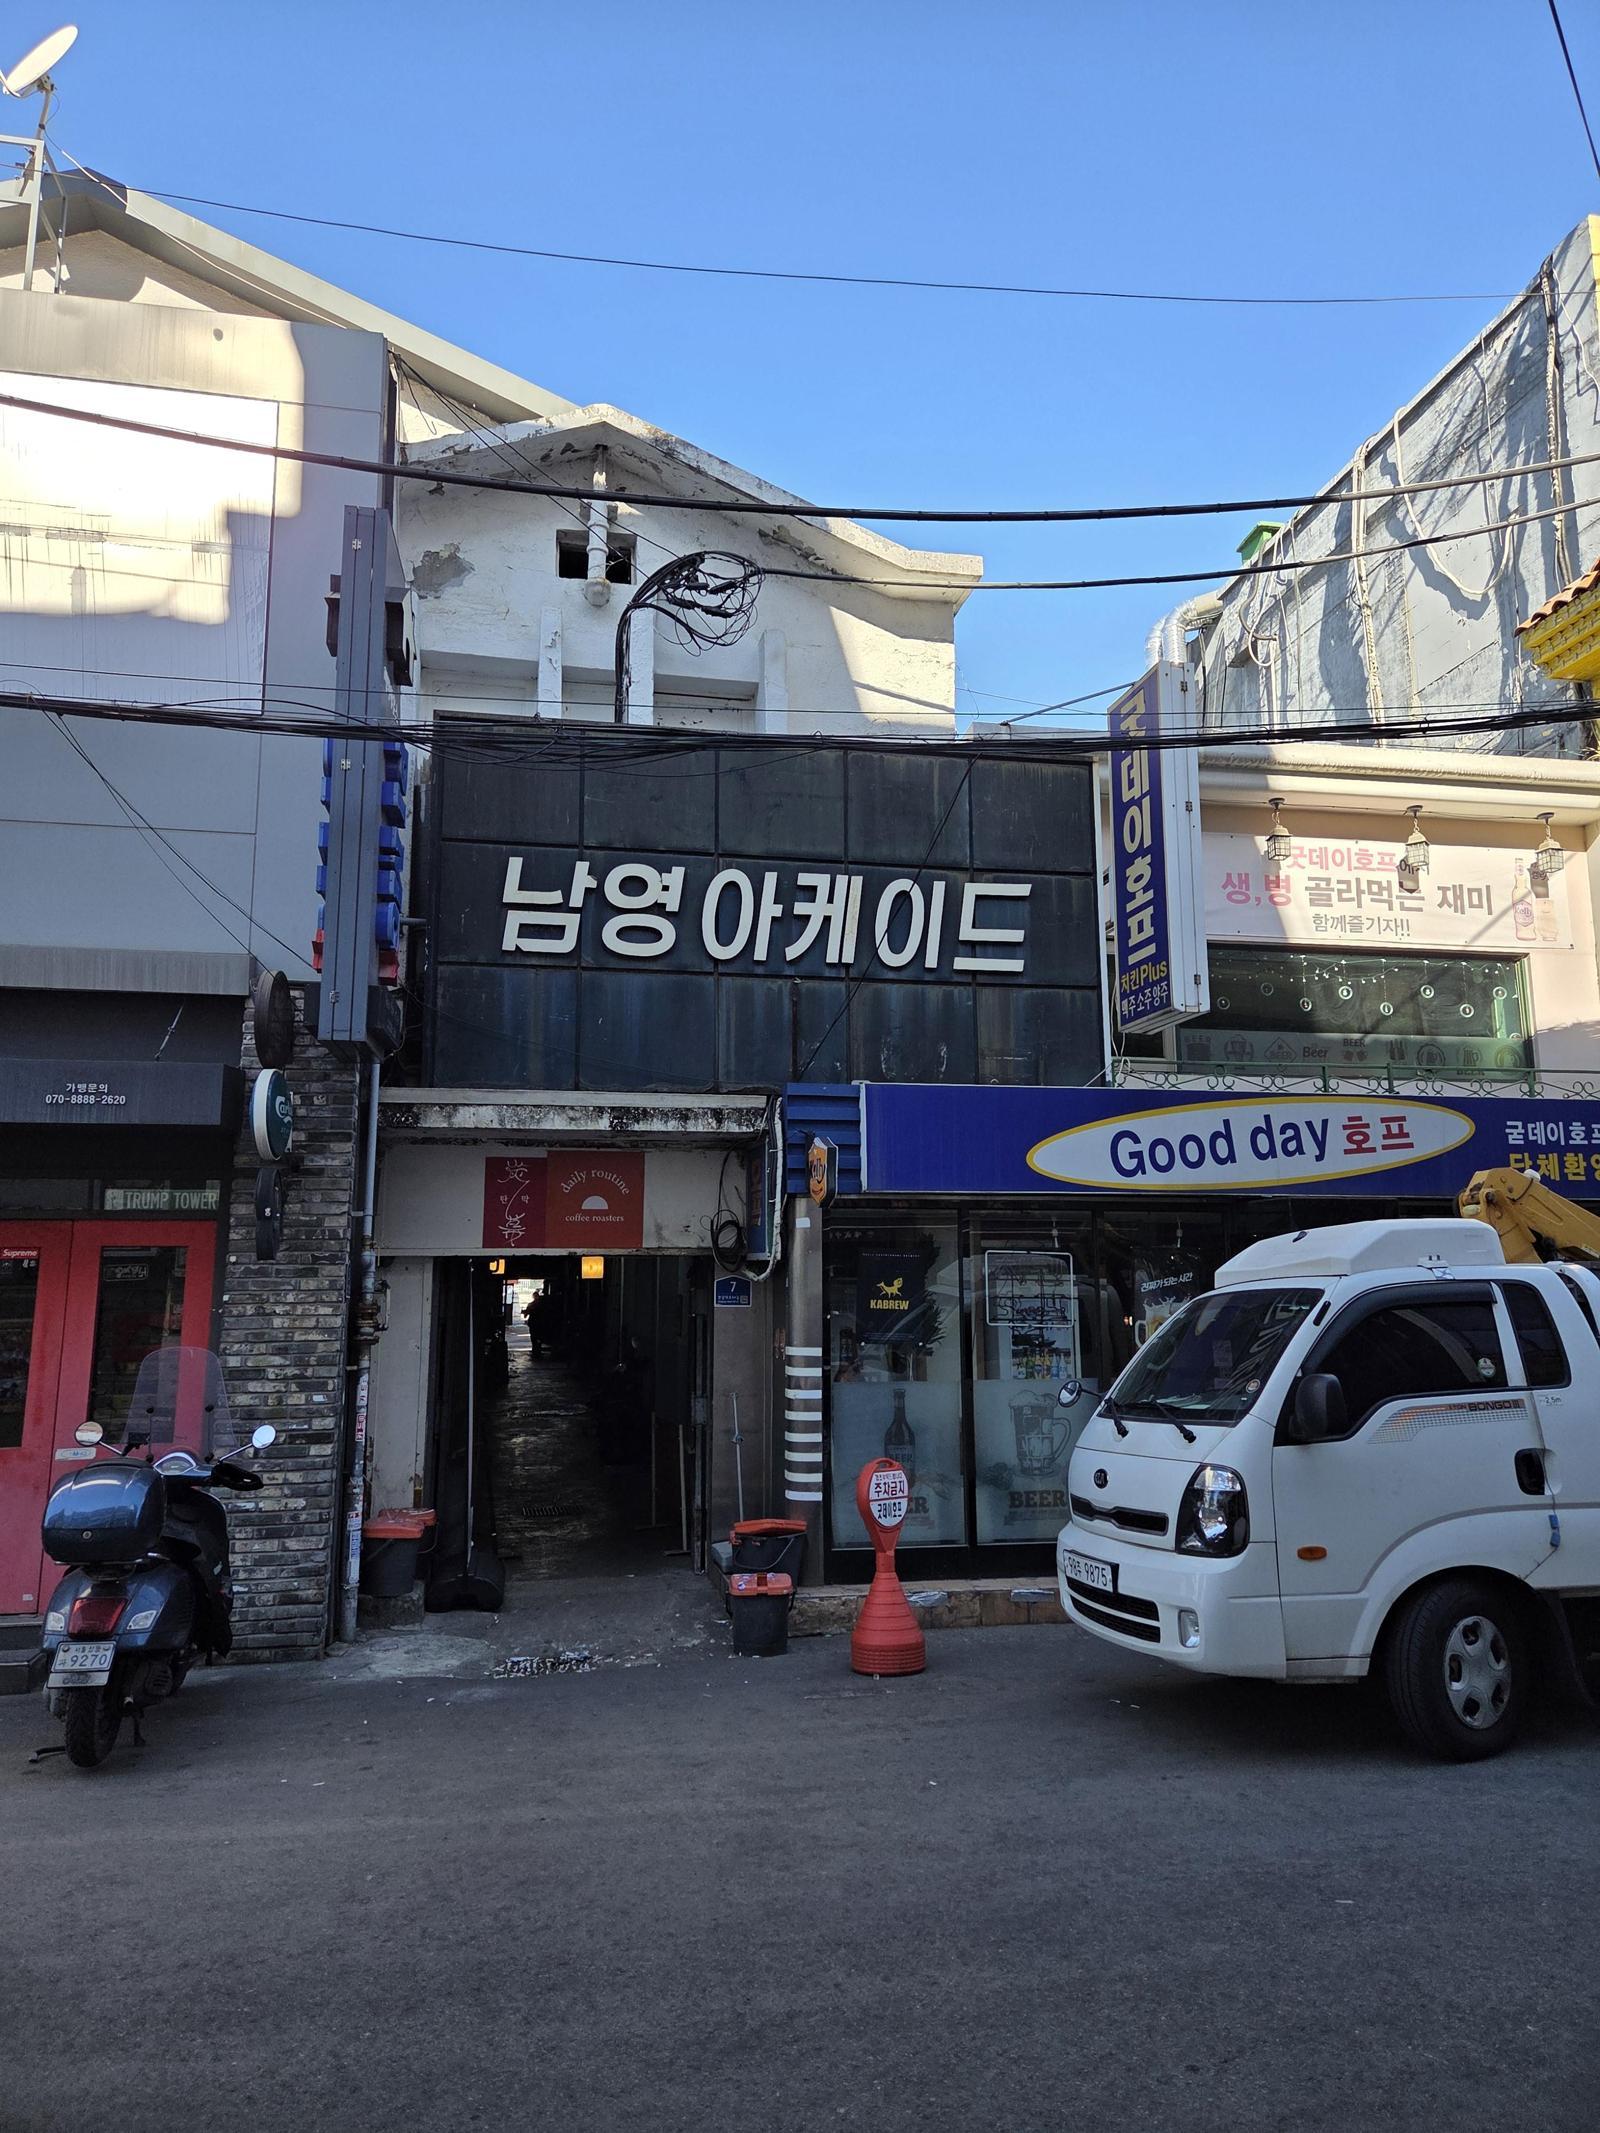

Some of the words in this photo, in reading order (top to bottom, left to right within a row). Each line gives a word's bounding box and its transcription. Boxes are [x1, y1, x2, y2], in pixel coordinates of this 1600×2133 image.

[1305, 876, 1425, 912] 골라먹는
[1437, 884, 1493, 915] 재미
[502, 857, 1033, 972] 남영아케이드
[1312, 913, 1411, 937] 함께즐기자!!
[1343, 1038, 1367, 1048] BEER
[1302, 1045, 1329, 1059] Beer
[45, 1094, 126, 1105] 070-8888-2620
[1110, 1118, 1237, 1178] Good
[1250, 1114, 1329, 1162] day
[1341, 1115, 1415, 1155] 호프
[560, 1168, 588, 1194] daily
[591, 1169, 630, 1195] routine
[125, 1192, 169, 1210] TRUMP
[174, 1193, 218, 1210] TOWER
[565, 1212, 590, 1222] coffee
[592, 1213, 625, 1222] roasters
[2, 1248, 38, 1258] Supreme
[730, 1281, 737, 1293] 7
[870, 1299, 910, 1311] KABREW
[1469, 1400, 1511, 1412] BONGO
[874, 1480, 905, 1498] 주차금지
[1008, 1490, 1068, 1509] BEER
[1084, 1562, 1108, 1587] 9875
[70, 1654, 108, 1667] 9270
